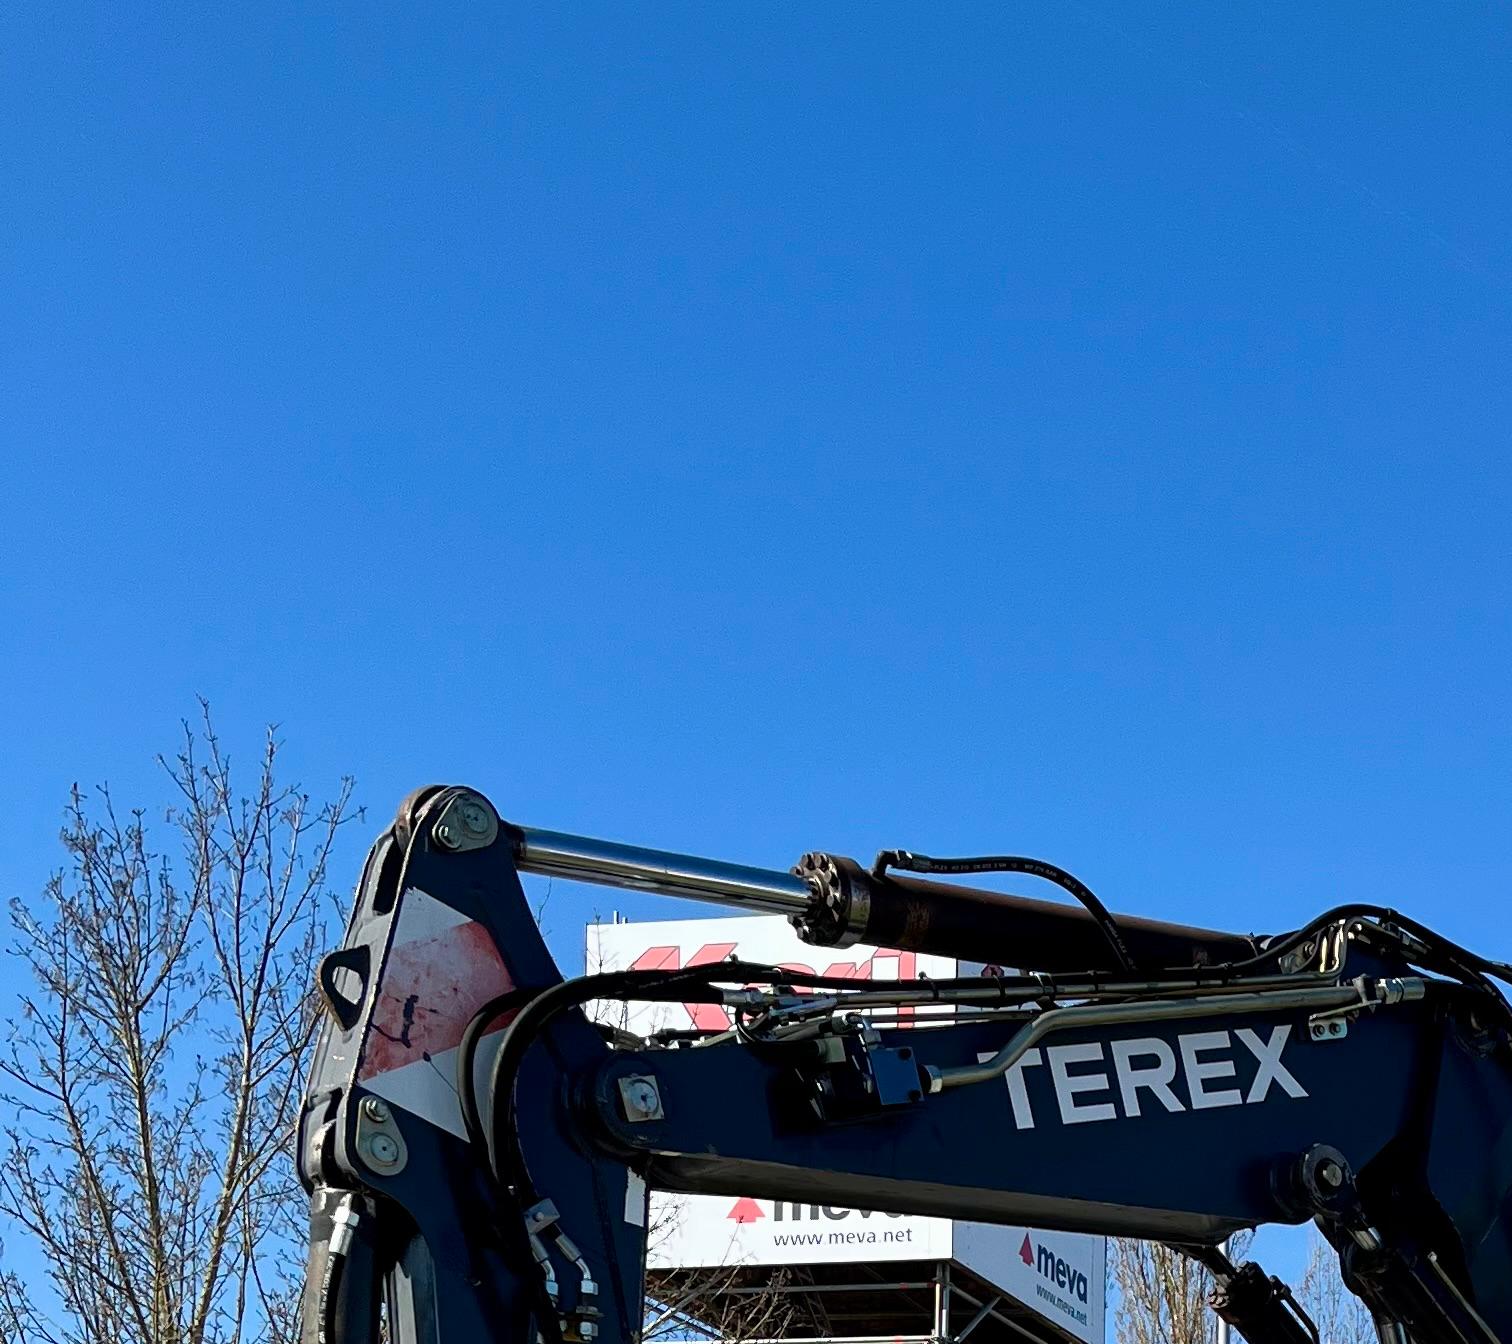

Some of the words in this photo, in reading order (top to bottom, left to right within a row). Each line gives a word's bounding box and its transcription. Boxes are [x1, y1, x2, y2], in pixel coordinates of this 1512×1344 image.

[976, 1024, 1310, 1130] TEREX
[773, 1227, 913, 1246] www.meva.net
[1037, 1243, 1088, 1304] meva
